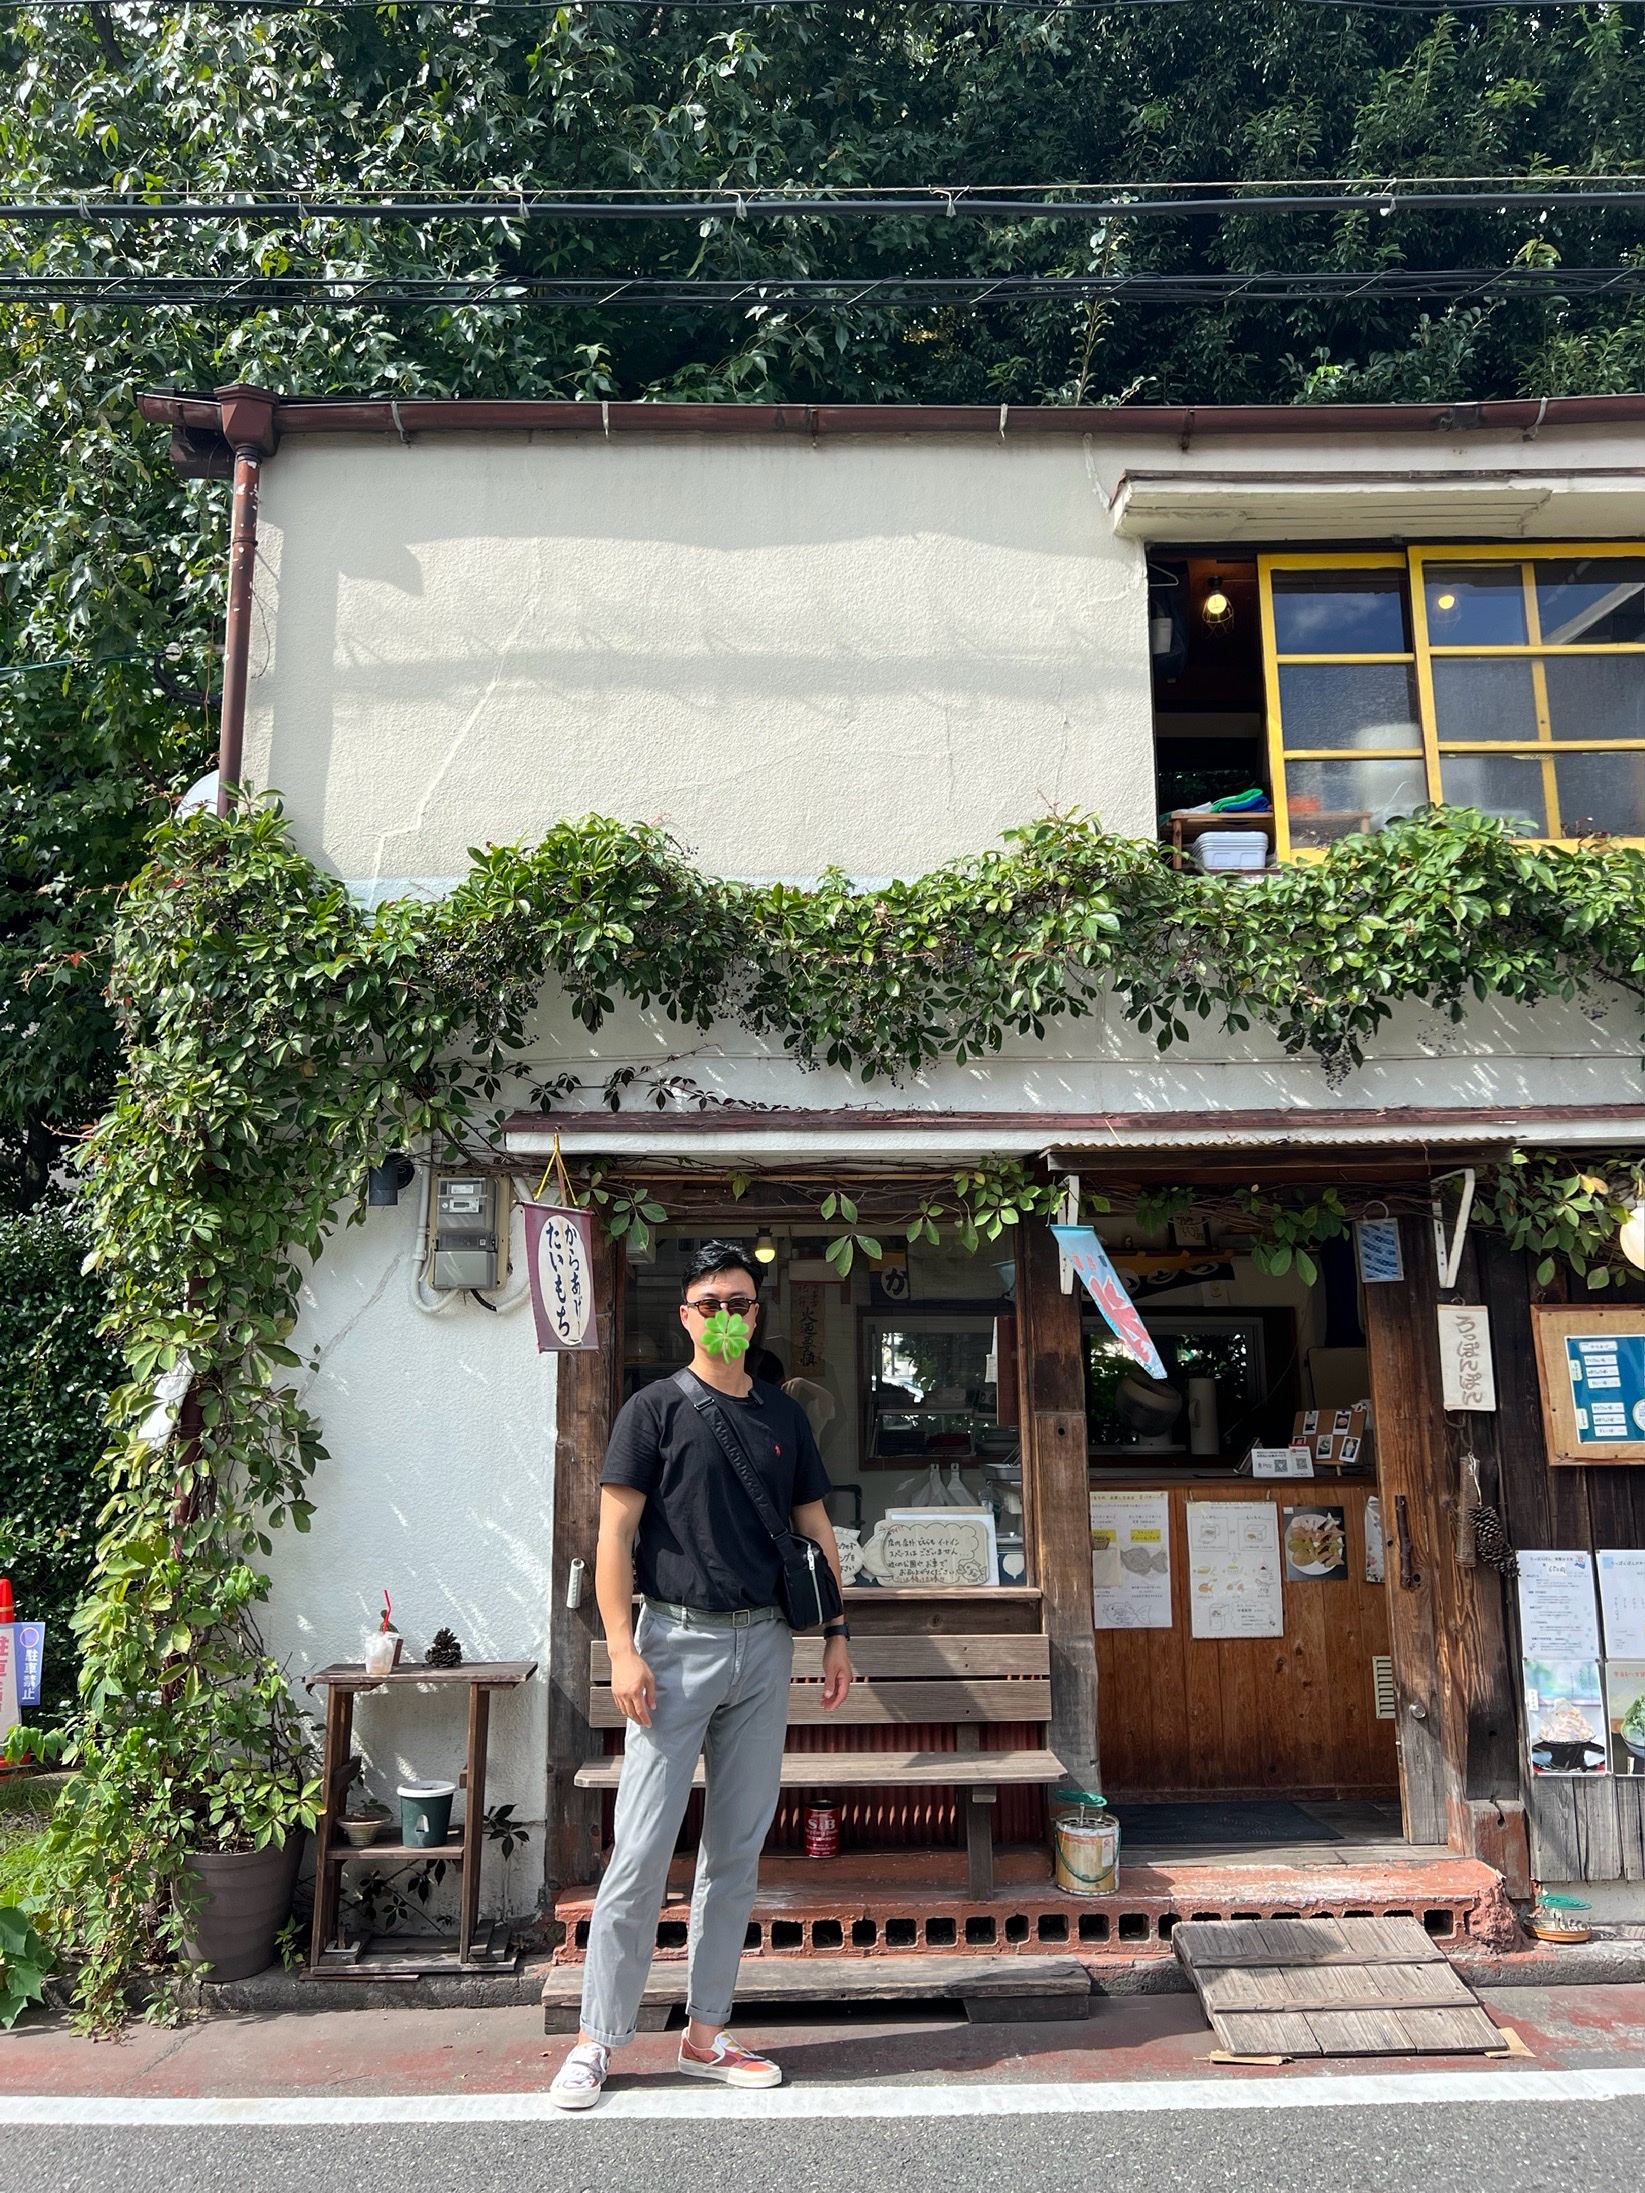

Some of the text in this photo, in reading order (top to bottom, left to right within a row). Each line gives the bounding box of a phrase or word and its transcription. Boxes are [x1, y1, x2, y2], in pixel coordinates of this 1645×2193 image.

[546, 1221, 570, 1337] たいもち
[1455, 1313, 1483, 1406] ろっぽんぽん
[22, 1649, 39, 1701] 駐車禁止
[807, 1818, 836, 1830] S&B
